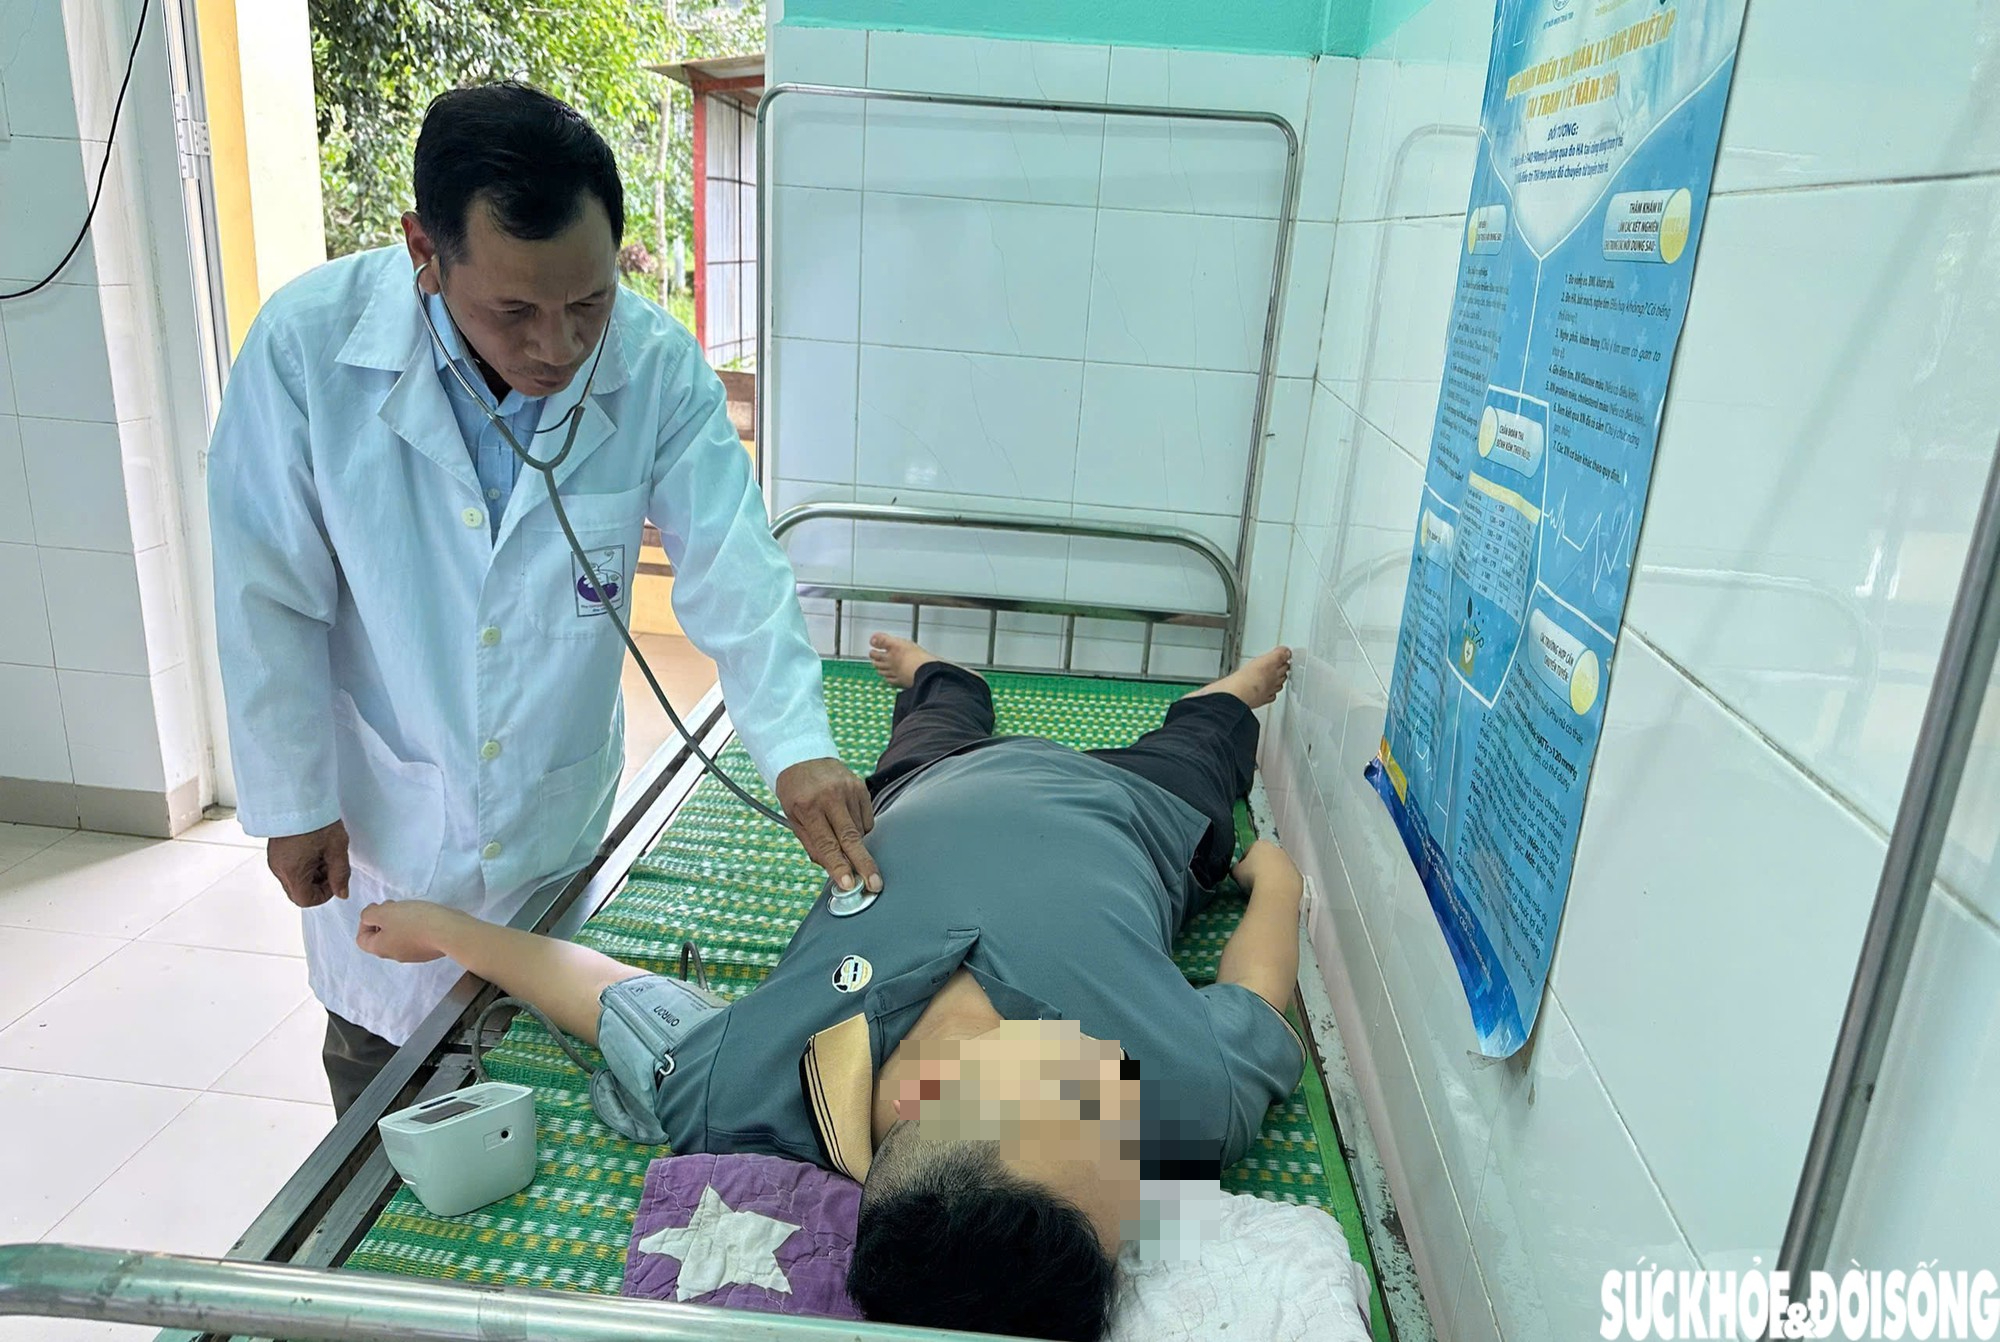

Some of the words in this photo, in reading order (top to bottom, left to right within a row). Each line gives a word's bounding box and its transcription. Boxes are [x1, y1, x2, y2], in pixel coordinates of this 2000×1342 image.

[1575, 76, 1600, 106] NĂM
[1638, 350, 1652, 361] gan
[653, 1005, 680, 1027] OMRON
